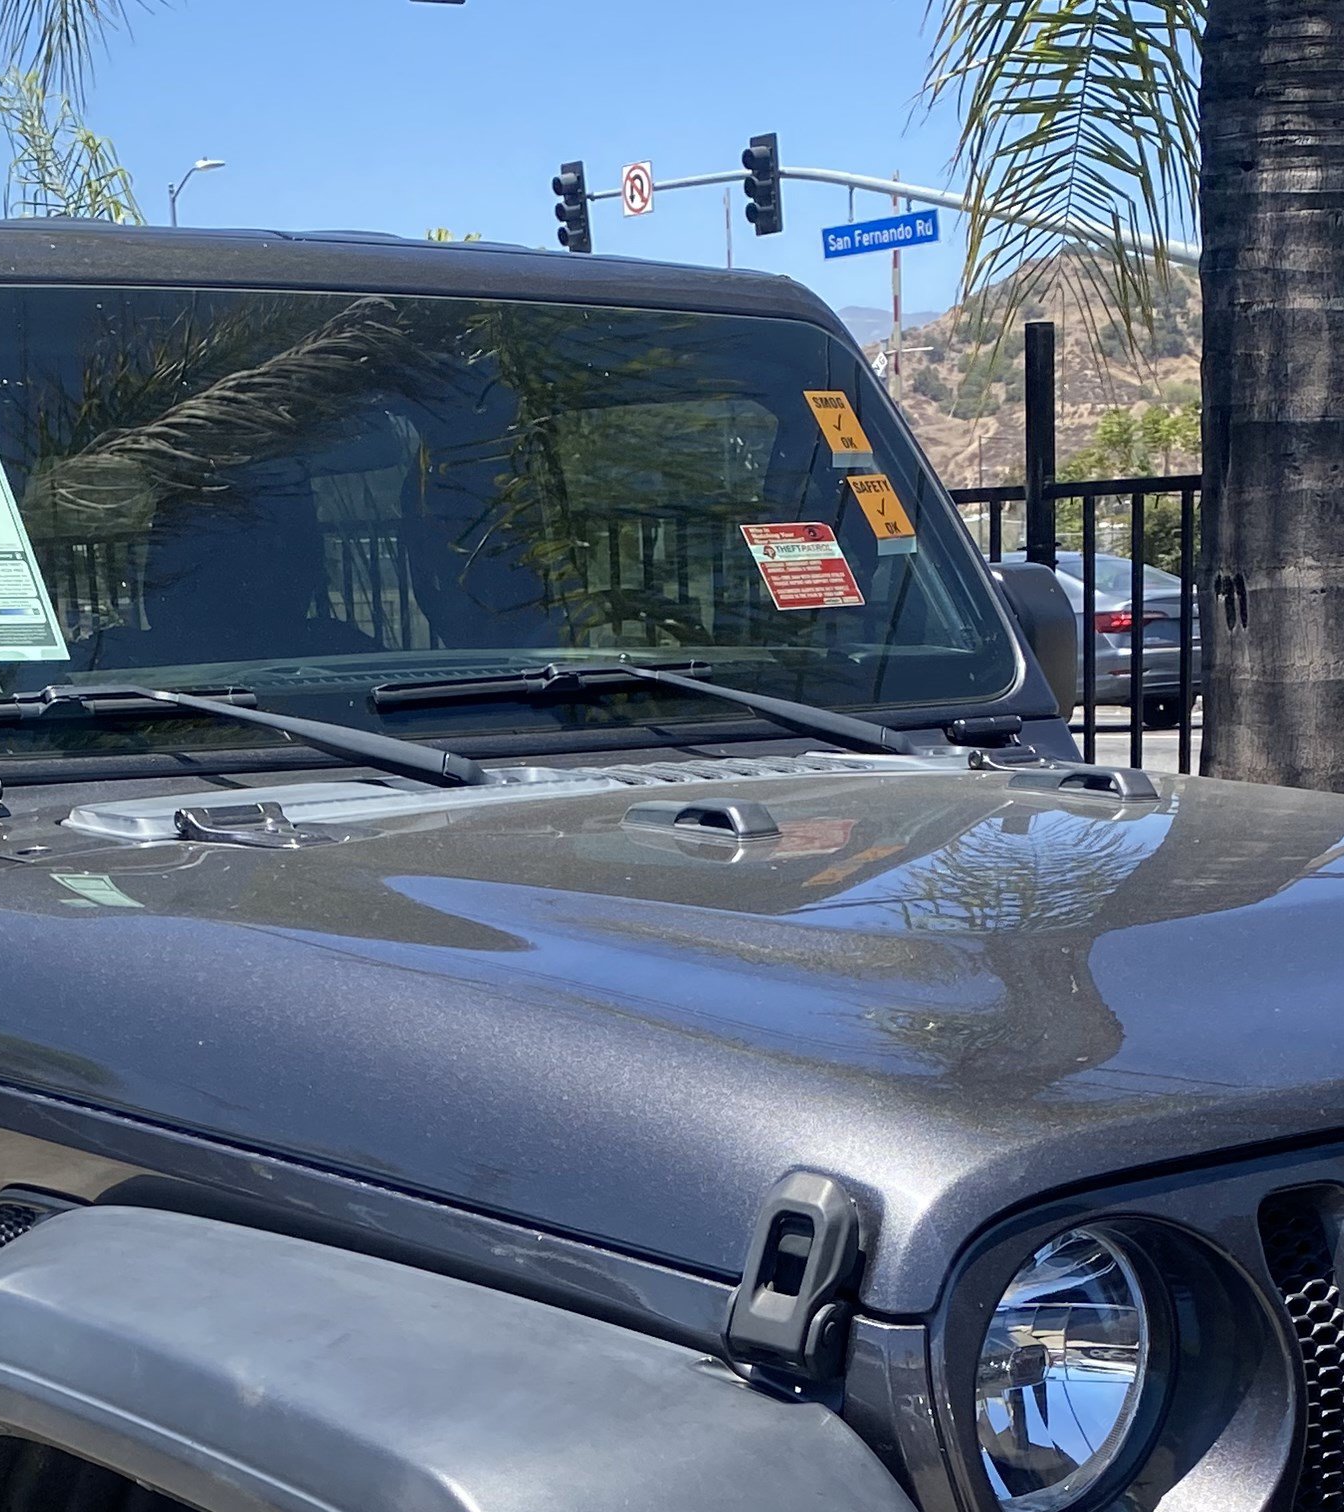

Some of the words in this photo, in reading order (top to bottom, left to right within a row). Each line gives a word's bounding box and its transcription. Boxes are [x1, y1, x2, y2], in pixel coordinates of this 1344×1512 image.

[827, 234, 851, 251] San
[854, 223, 913, 247] Fernando
[915, 219, 934, 237] Rd
[812, 396, 846, 410] SMOG
[840, 436, 858, 449] OK
[852, 479, 891, 493] SAFETY
[884, 521, 902, 534] OK
